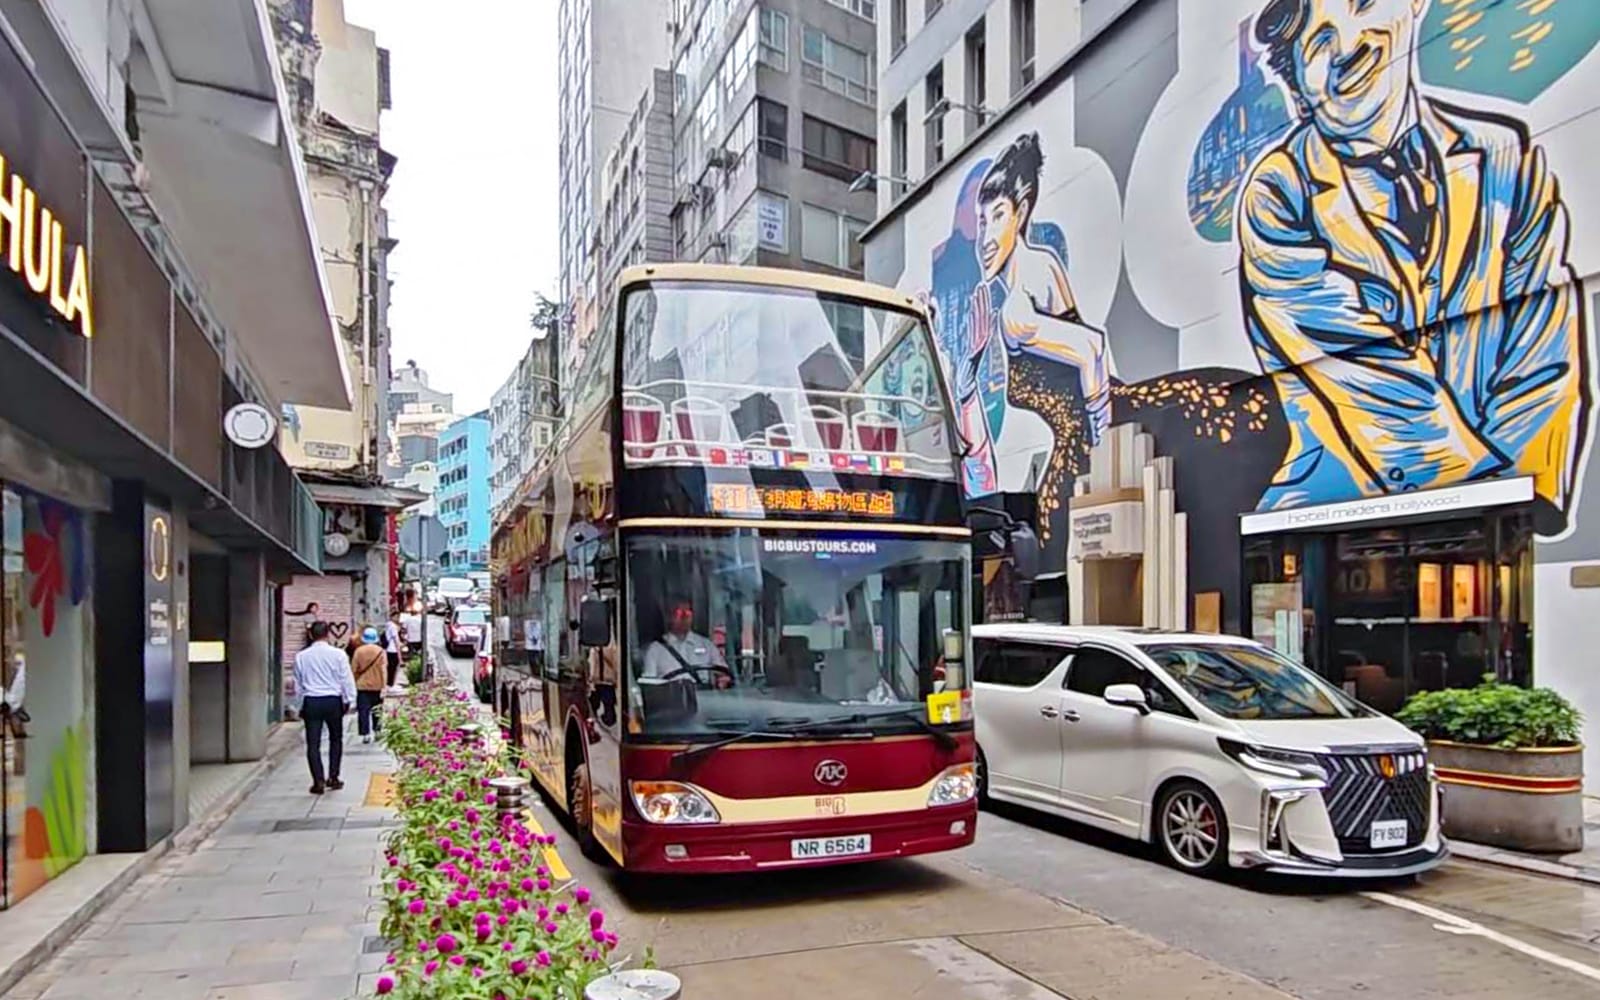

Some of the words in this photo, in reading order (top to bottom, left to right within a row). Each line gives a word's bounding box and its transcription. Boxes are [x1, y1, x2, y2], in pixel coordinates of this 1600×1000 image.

[1287, 508, 1329, 525] hotel
[1394, 494, 1461, 512] hollywood
[764, 540, 876, 553] BIGBUSTOURS.COM
[798, 841, 820, 855] NR
[825, 838, 865, 853] 6564
